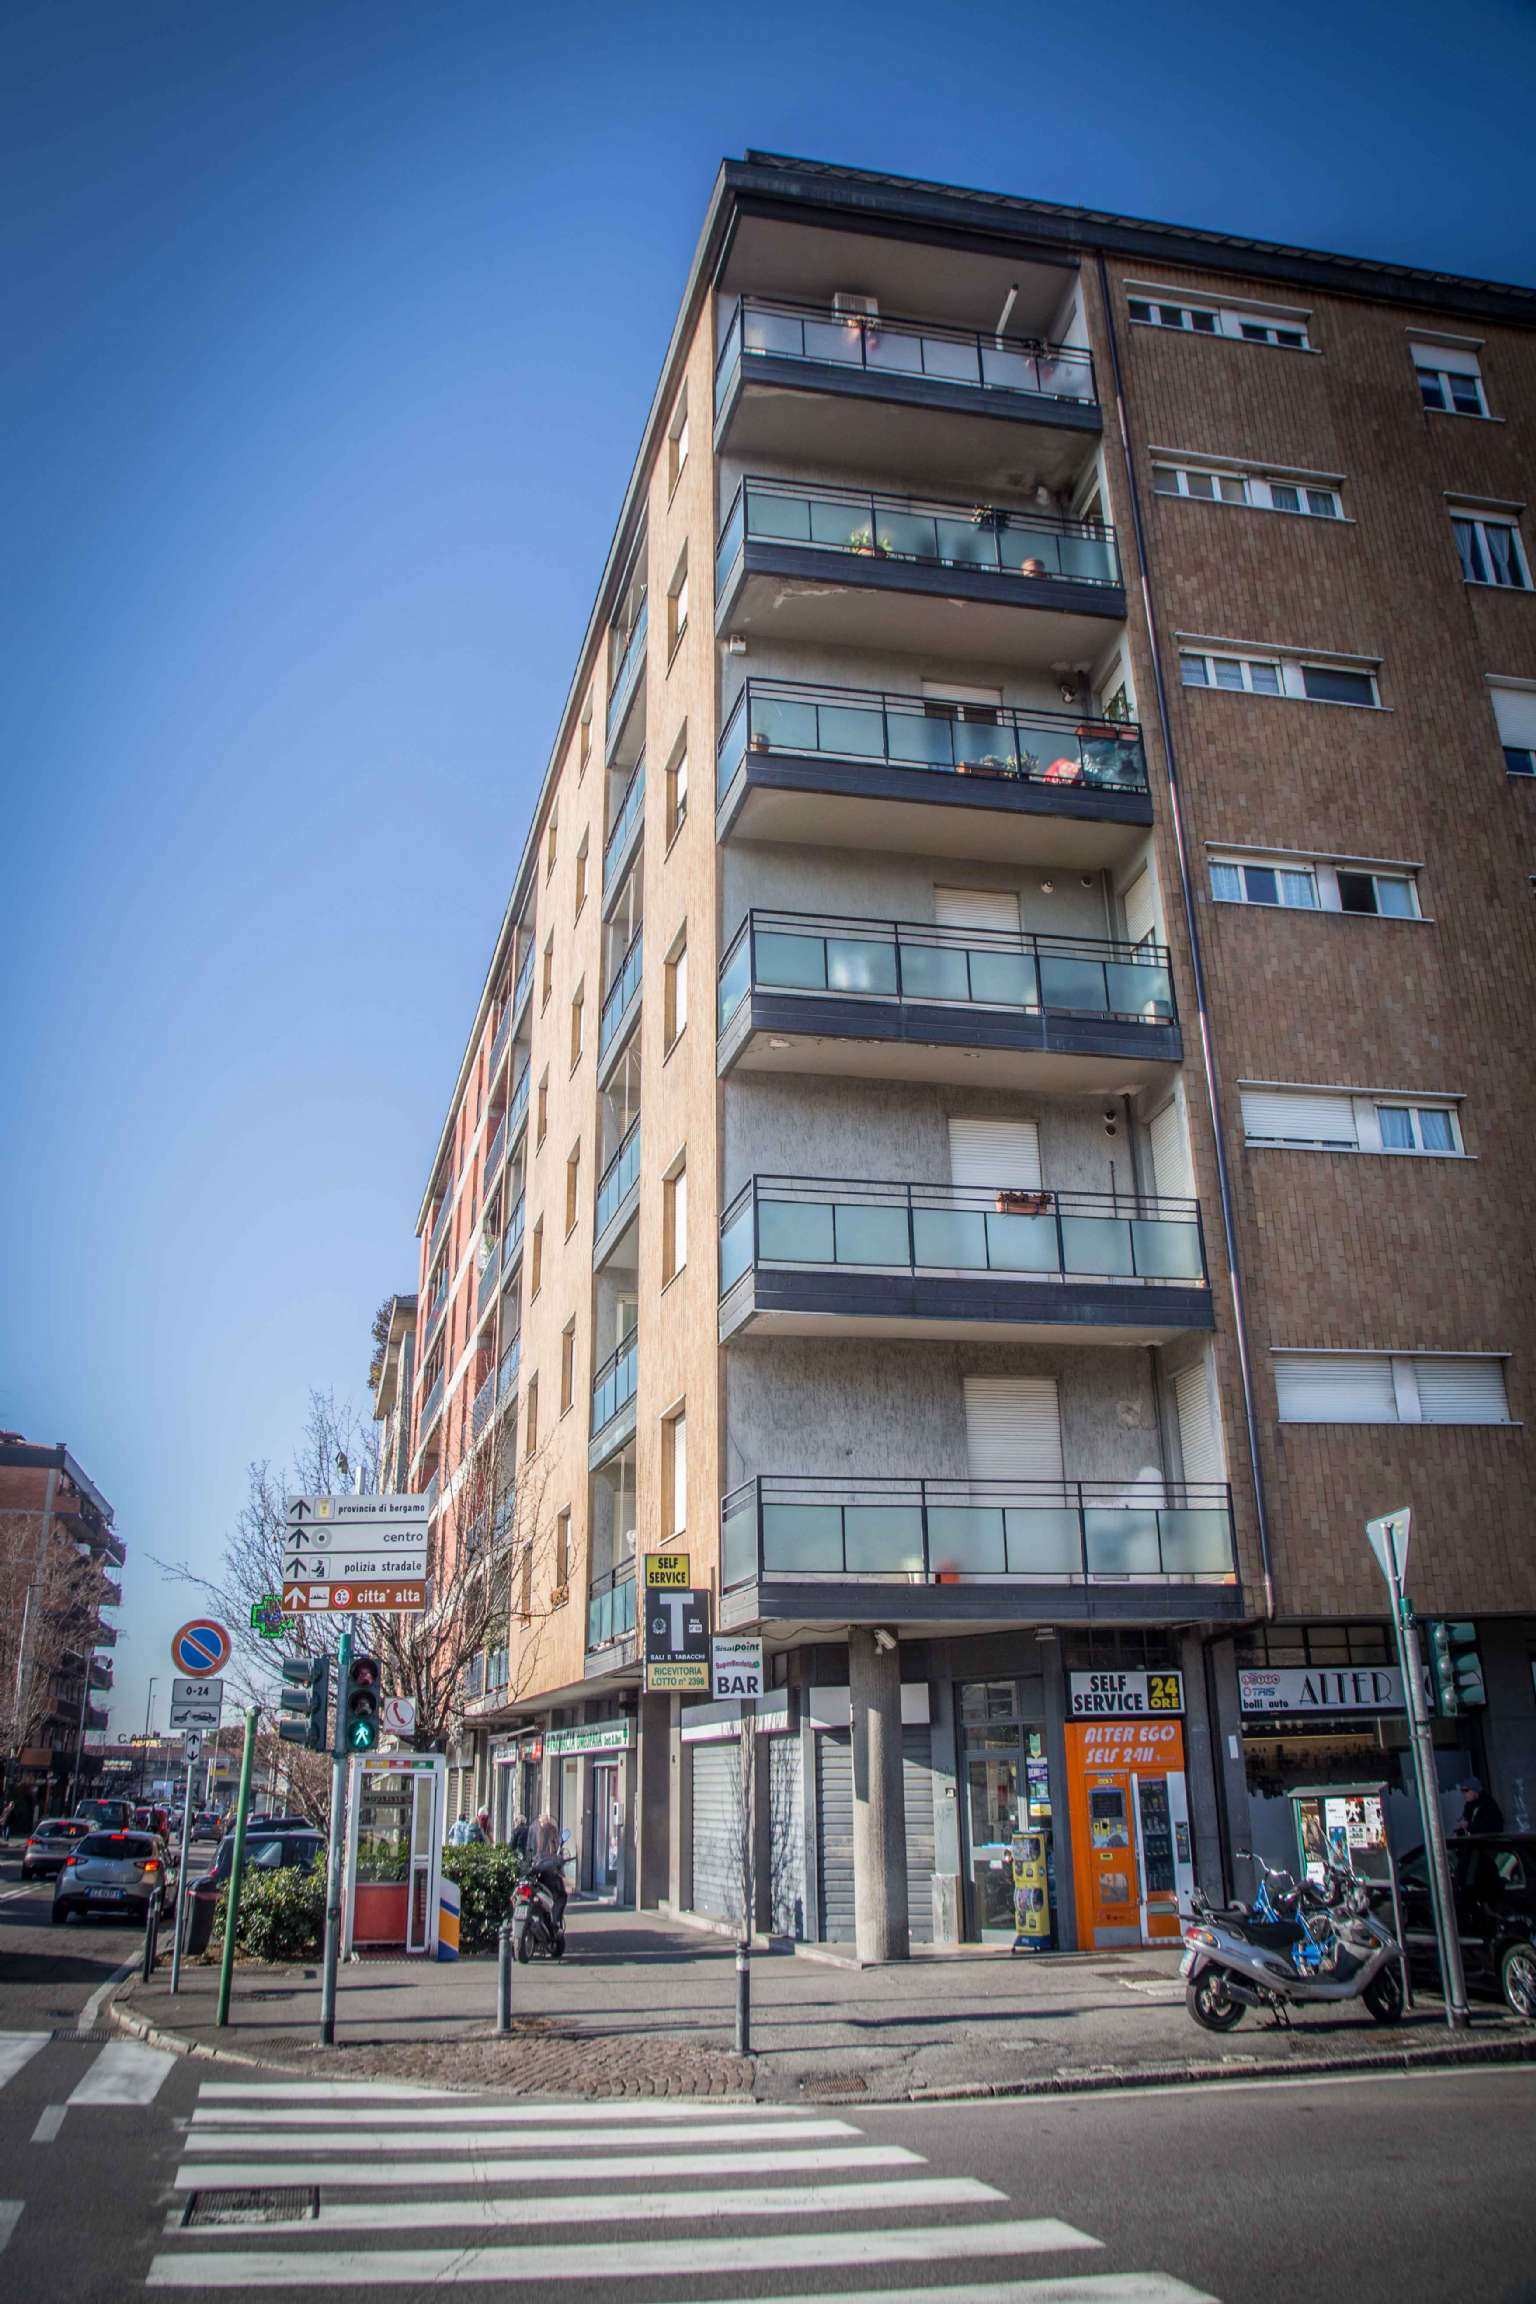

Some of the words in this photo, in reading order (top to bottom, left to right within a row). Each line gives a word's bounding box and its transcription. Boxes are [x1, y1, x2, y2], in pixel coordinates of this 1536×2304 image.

[338, 1504, 376, 1514] provincia
[378, 1503, 388, 1513] di
[389, 1503, 425, 1514] bergamo
[383, 1532, 424, 1542] centro
[344, 1562, 376, 1574] polizia
[381, 1561, 422, 1572] stradale
[658, 1557, 679, 1569] SELF
[649, 1572, 686, 1584] SERVICE
[395, 1588, 421, 1603] alta
[659, 1593, 694, 1651] T
[654, 1666, 703, 1677] RICEVITORIA
[651, 1677, 677, 1687] LOTTO
[717, 1676, 759, 1695] BAR
[1090, 1675, 1127, 1692] SELF
[1151, 1677, 1178, 1697] 24
[1299, 1671, 1393, 1705] ALTER
[186, 1686, 209, 1696] 0-24
[1074, 1693, 1144, 1712] SERVICE
[1151, 1698, 1180, 1708] ORE
[1243, 1698, 1263, 1709] bolli
[1268, 1699, 1289, 1708] auto
[1085, 1727, 1135, 1744] ALTER
[1139, 1725, 1176, 1742] EGO
[1086, 1747, 1120, 1764] SELF
